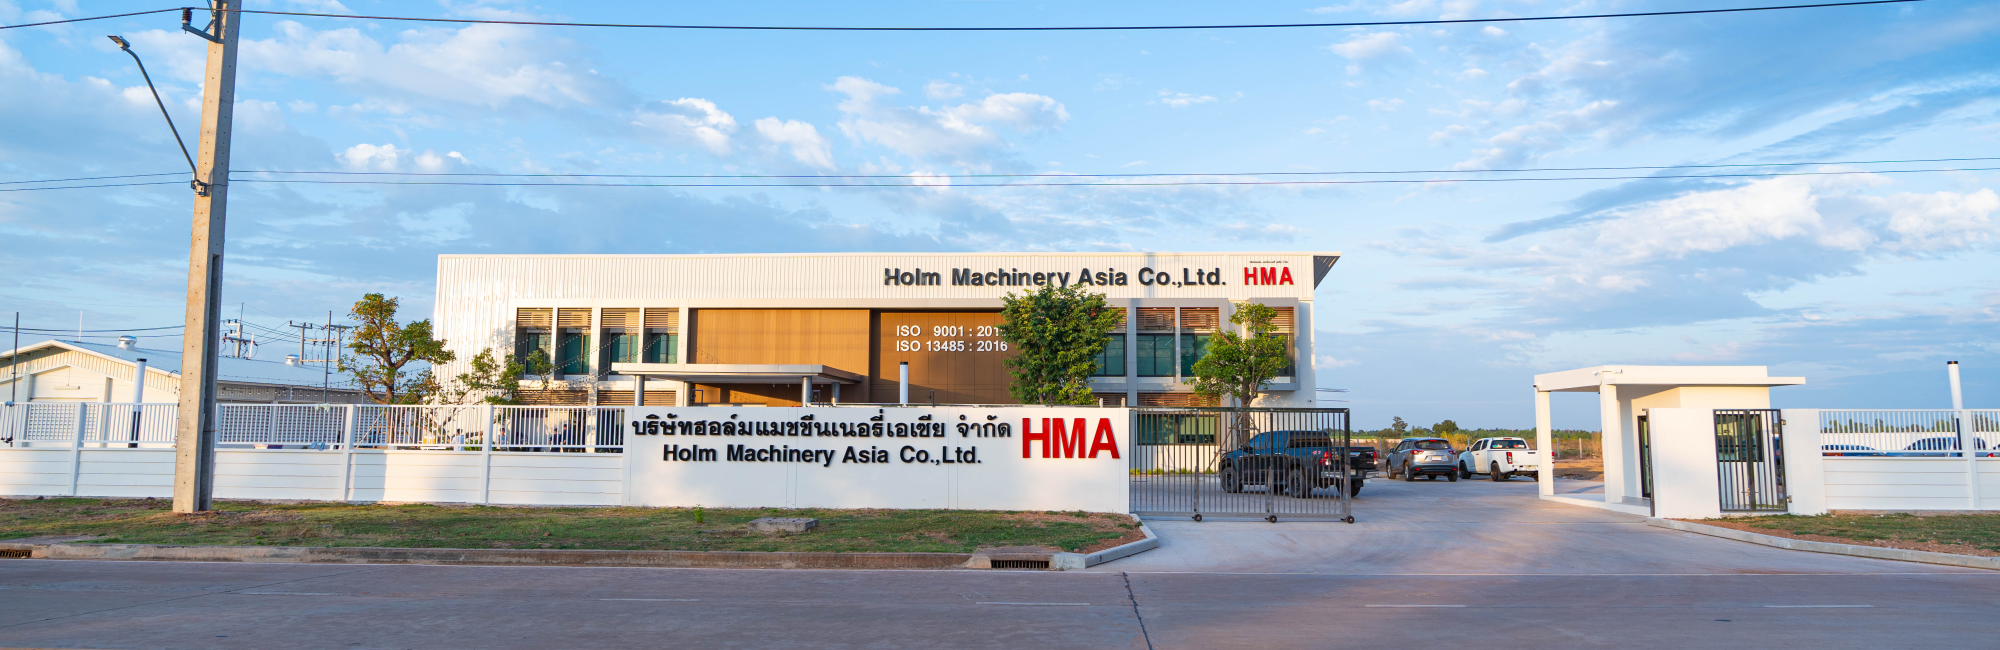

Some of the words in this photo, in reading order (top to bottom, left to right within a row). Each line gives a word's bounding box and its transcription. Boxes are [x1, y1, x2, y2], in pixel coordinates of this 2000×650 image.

[884, 267, 941, 286] Holm
[952, 267, 1071, 290] Machinery
[1078, 267, 1128, 286] Asia
[1138, 267, 1227, 288] Co.,Ltd.
[1244, 266, 1294, 286] HMA
[896, 325, 921, 337] ISO
[933, 325, 964, 337] 9001
[896, 340, 921, 352] ISO
[926, 340, 965, 352] 13485
[976, 340, 1008, 352] 2016
[956, 414, 1012, 438] จำกัด
[1022, 417, 1121, 460] HMA
[663, 444, 718, 462] Holm
[726, 444, 835, 468] Machinery
[842, 445, 890, 463] Asia
[899, 445, 982, 466] Co.,Ltd.
